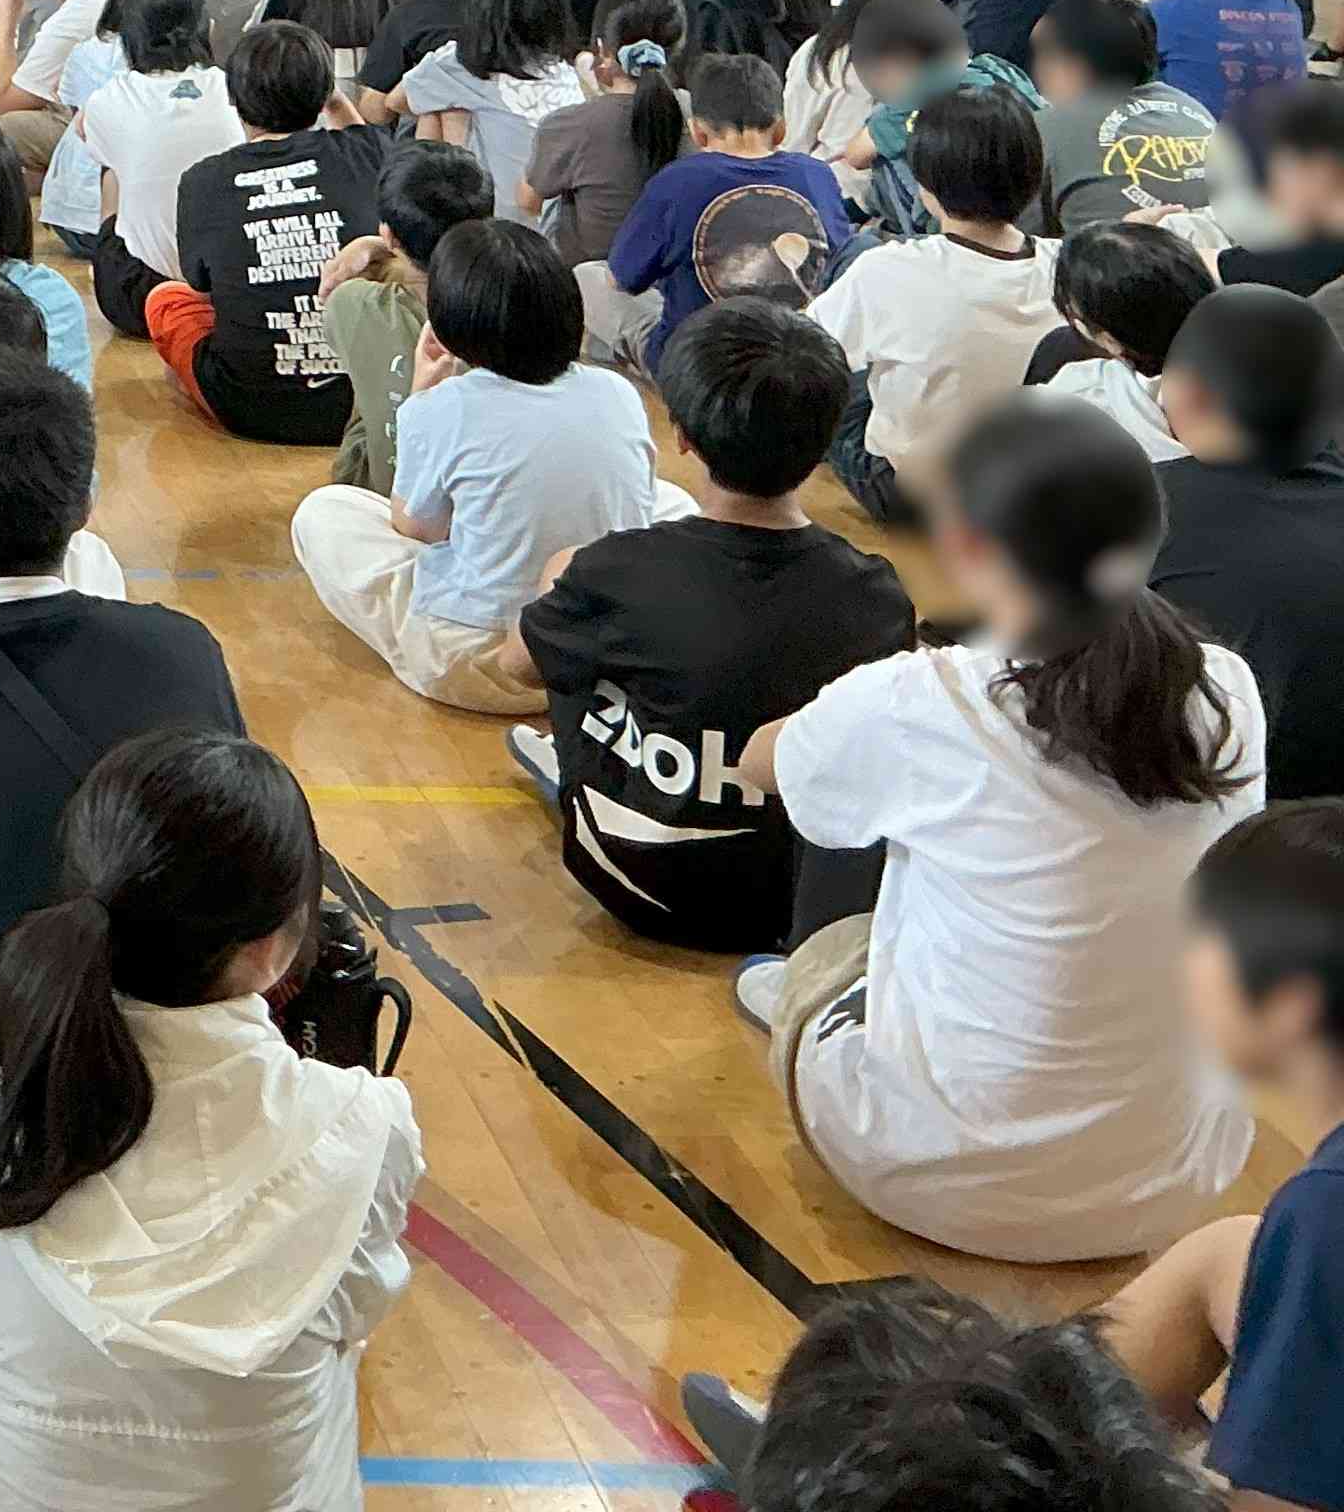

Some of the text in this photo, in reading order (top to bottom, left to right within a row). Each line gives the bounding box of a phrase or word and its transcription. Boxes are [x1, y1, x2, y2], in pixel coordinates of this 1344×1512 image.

[246, 186, 323, 210] JOURNEY.
[242, 210, 345, 239] WE WILL ALL
[256, 227, 339, 253] ARRIVE AT
[247, 262, 320, 284] DESTINAT
[265, 312, 297, 329] THE
